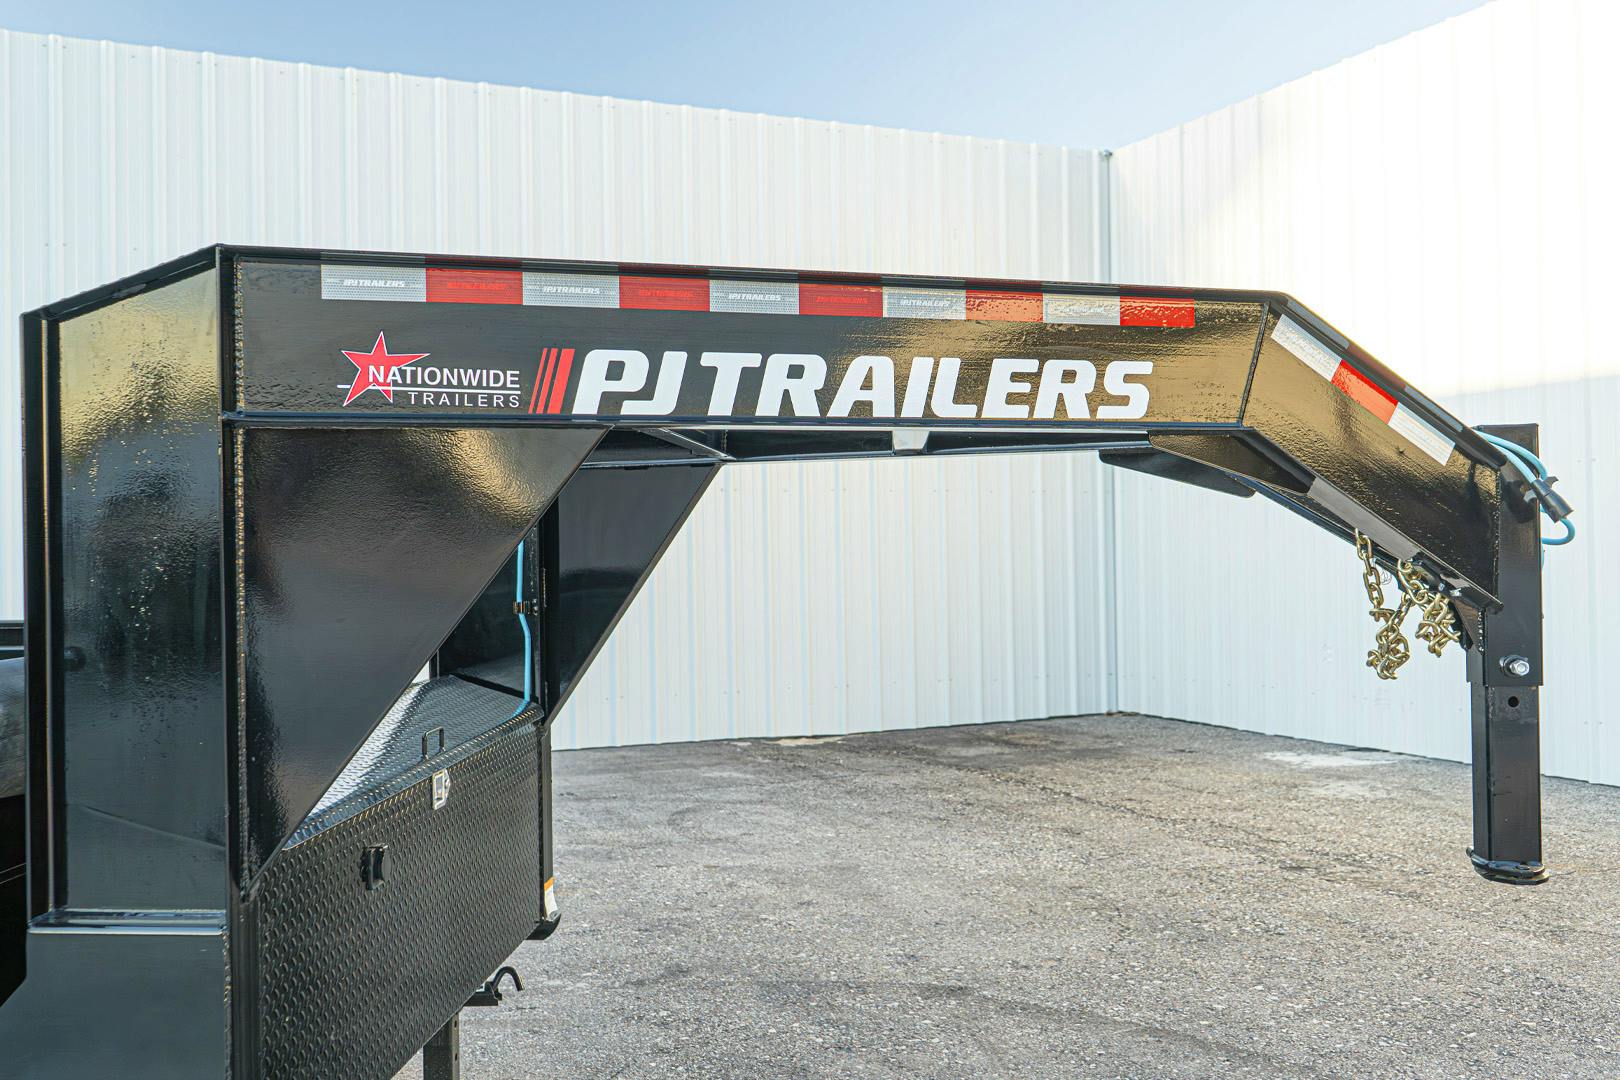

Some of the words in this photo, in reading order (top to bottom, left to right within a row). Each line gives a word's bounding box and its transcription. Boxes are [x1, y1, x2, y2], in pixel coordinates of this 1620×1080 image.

[368, 365, 520, 388] NATIONWIDE
[700, 352, 1153, 419] TRAILERS
[408, 392, 520, 408] TRAILERS
